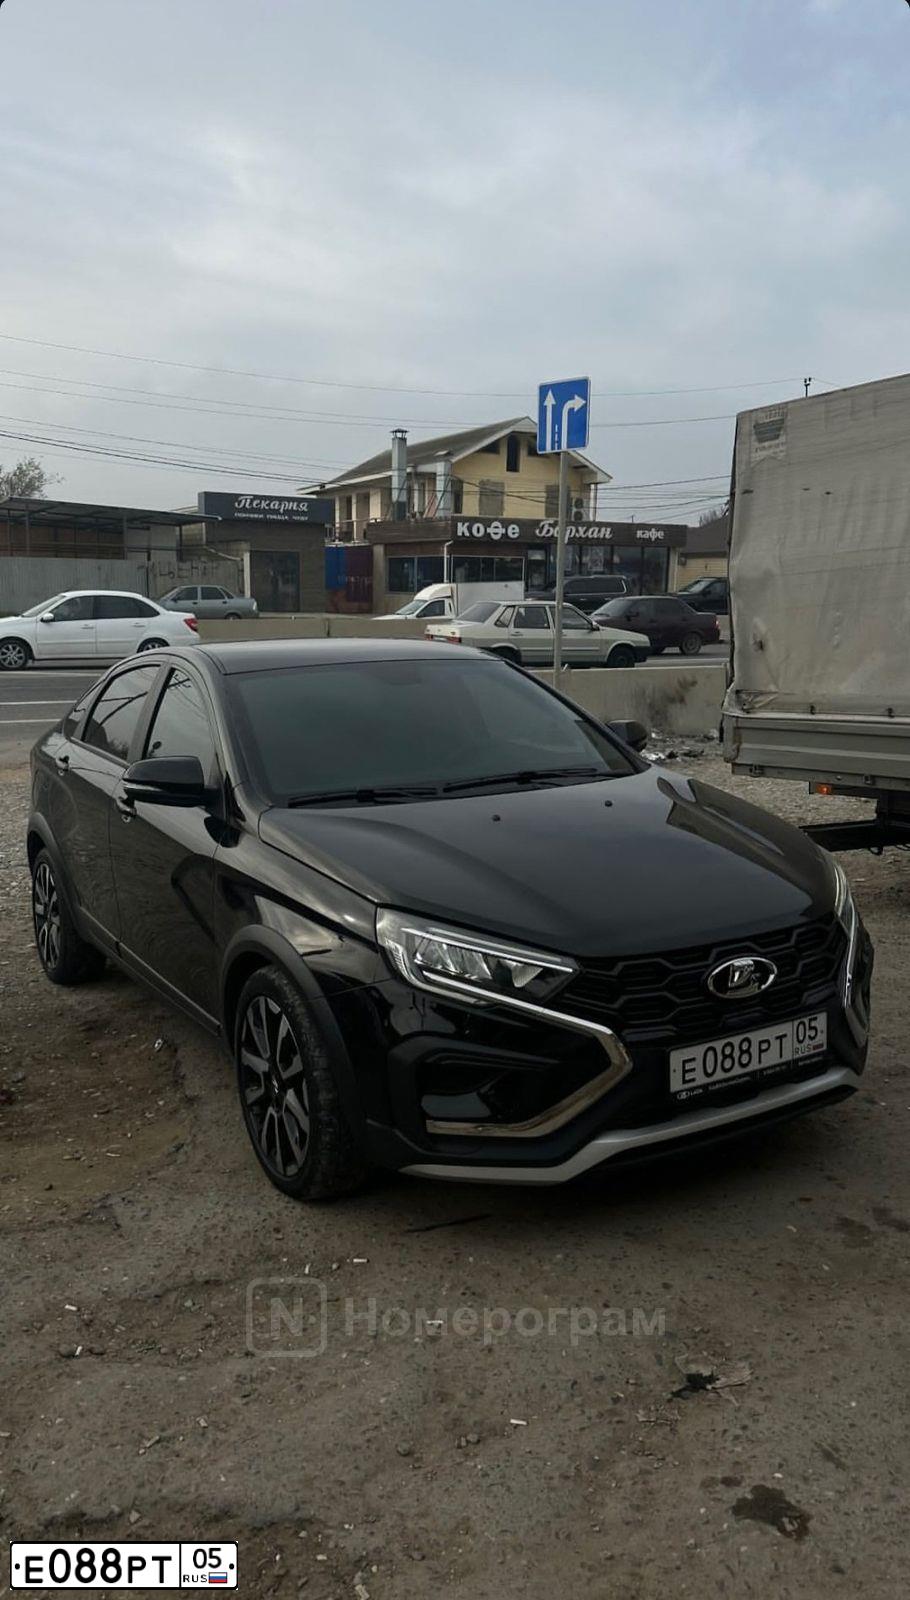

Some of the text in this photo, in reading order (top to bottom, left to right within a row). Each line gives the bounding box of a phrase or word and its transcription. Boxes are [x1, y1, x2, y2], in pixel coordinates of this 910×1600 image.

[235, 496, 308, 513] Пекарня
[636, 527, 665, 542] кафе
[796, 1017, 818, 1044] 05
[794, 1044, 812, 1057] RUS
